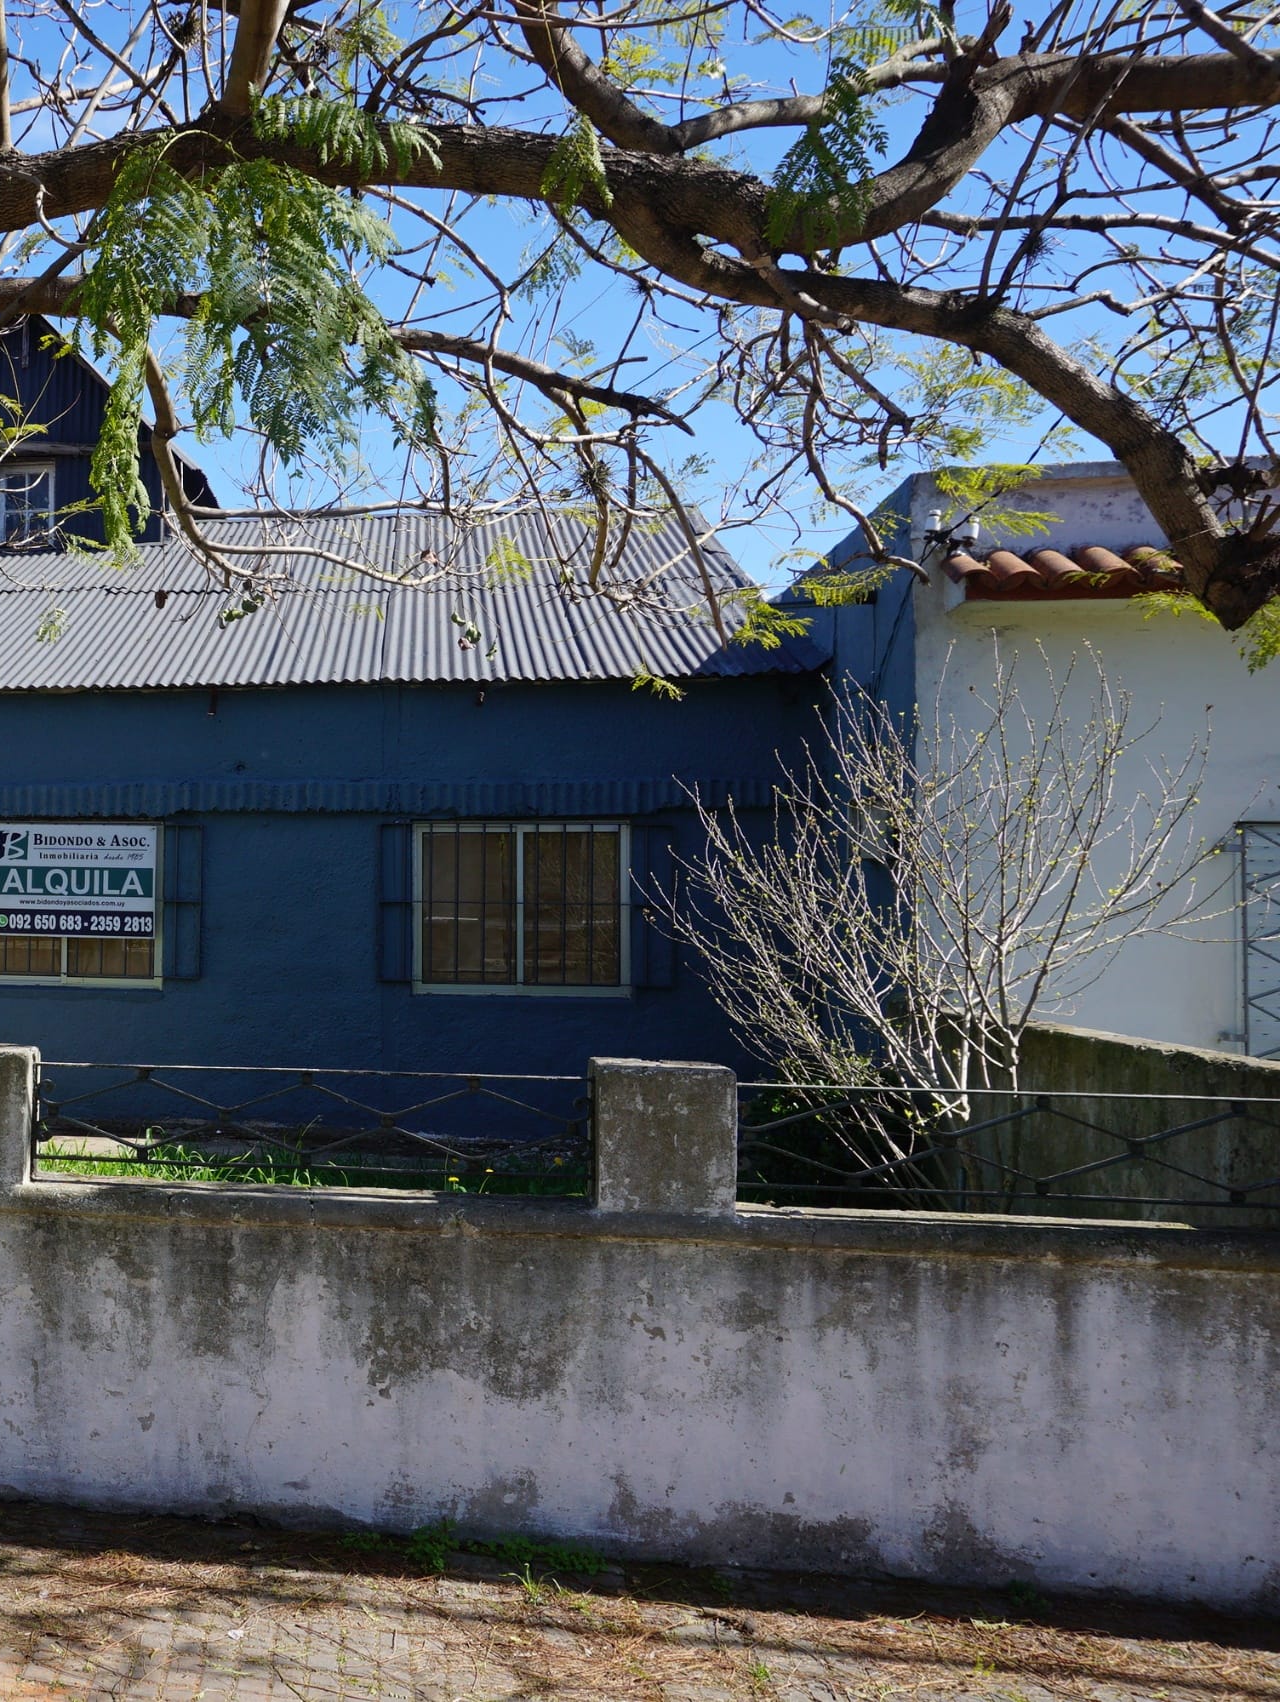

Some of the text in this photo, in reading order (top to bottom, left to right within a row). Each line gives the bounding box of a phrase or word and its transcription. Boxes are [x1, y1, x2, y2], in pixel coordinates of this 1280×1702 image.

[33, 833, 150, 848] BIDONDO & ASOC.
[39, 851, 99, 860] Inmobiliaria
[2, 868, 144, 896] ALQUILA
[19, 898, 126, 908] www.bidondoyasociados.com.uy
[9, 913, 31, 930] 092
[34, 914, 56, 930] 650
[59, 914, 82, 931] 683
[90, 916, 121, 932] 2359
[124, 916, 153, 933] 2813
